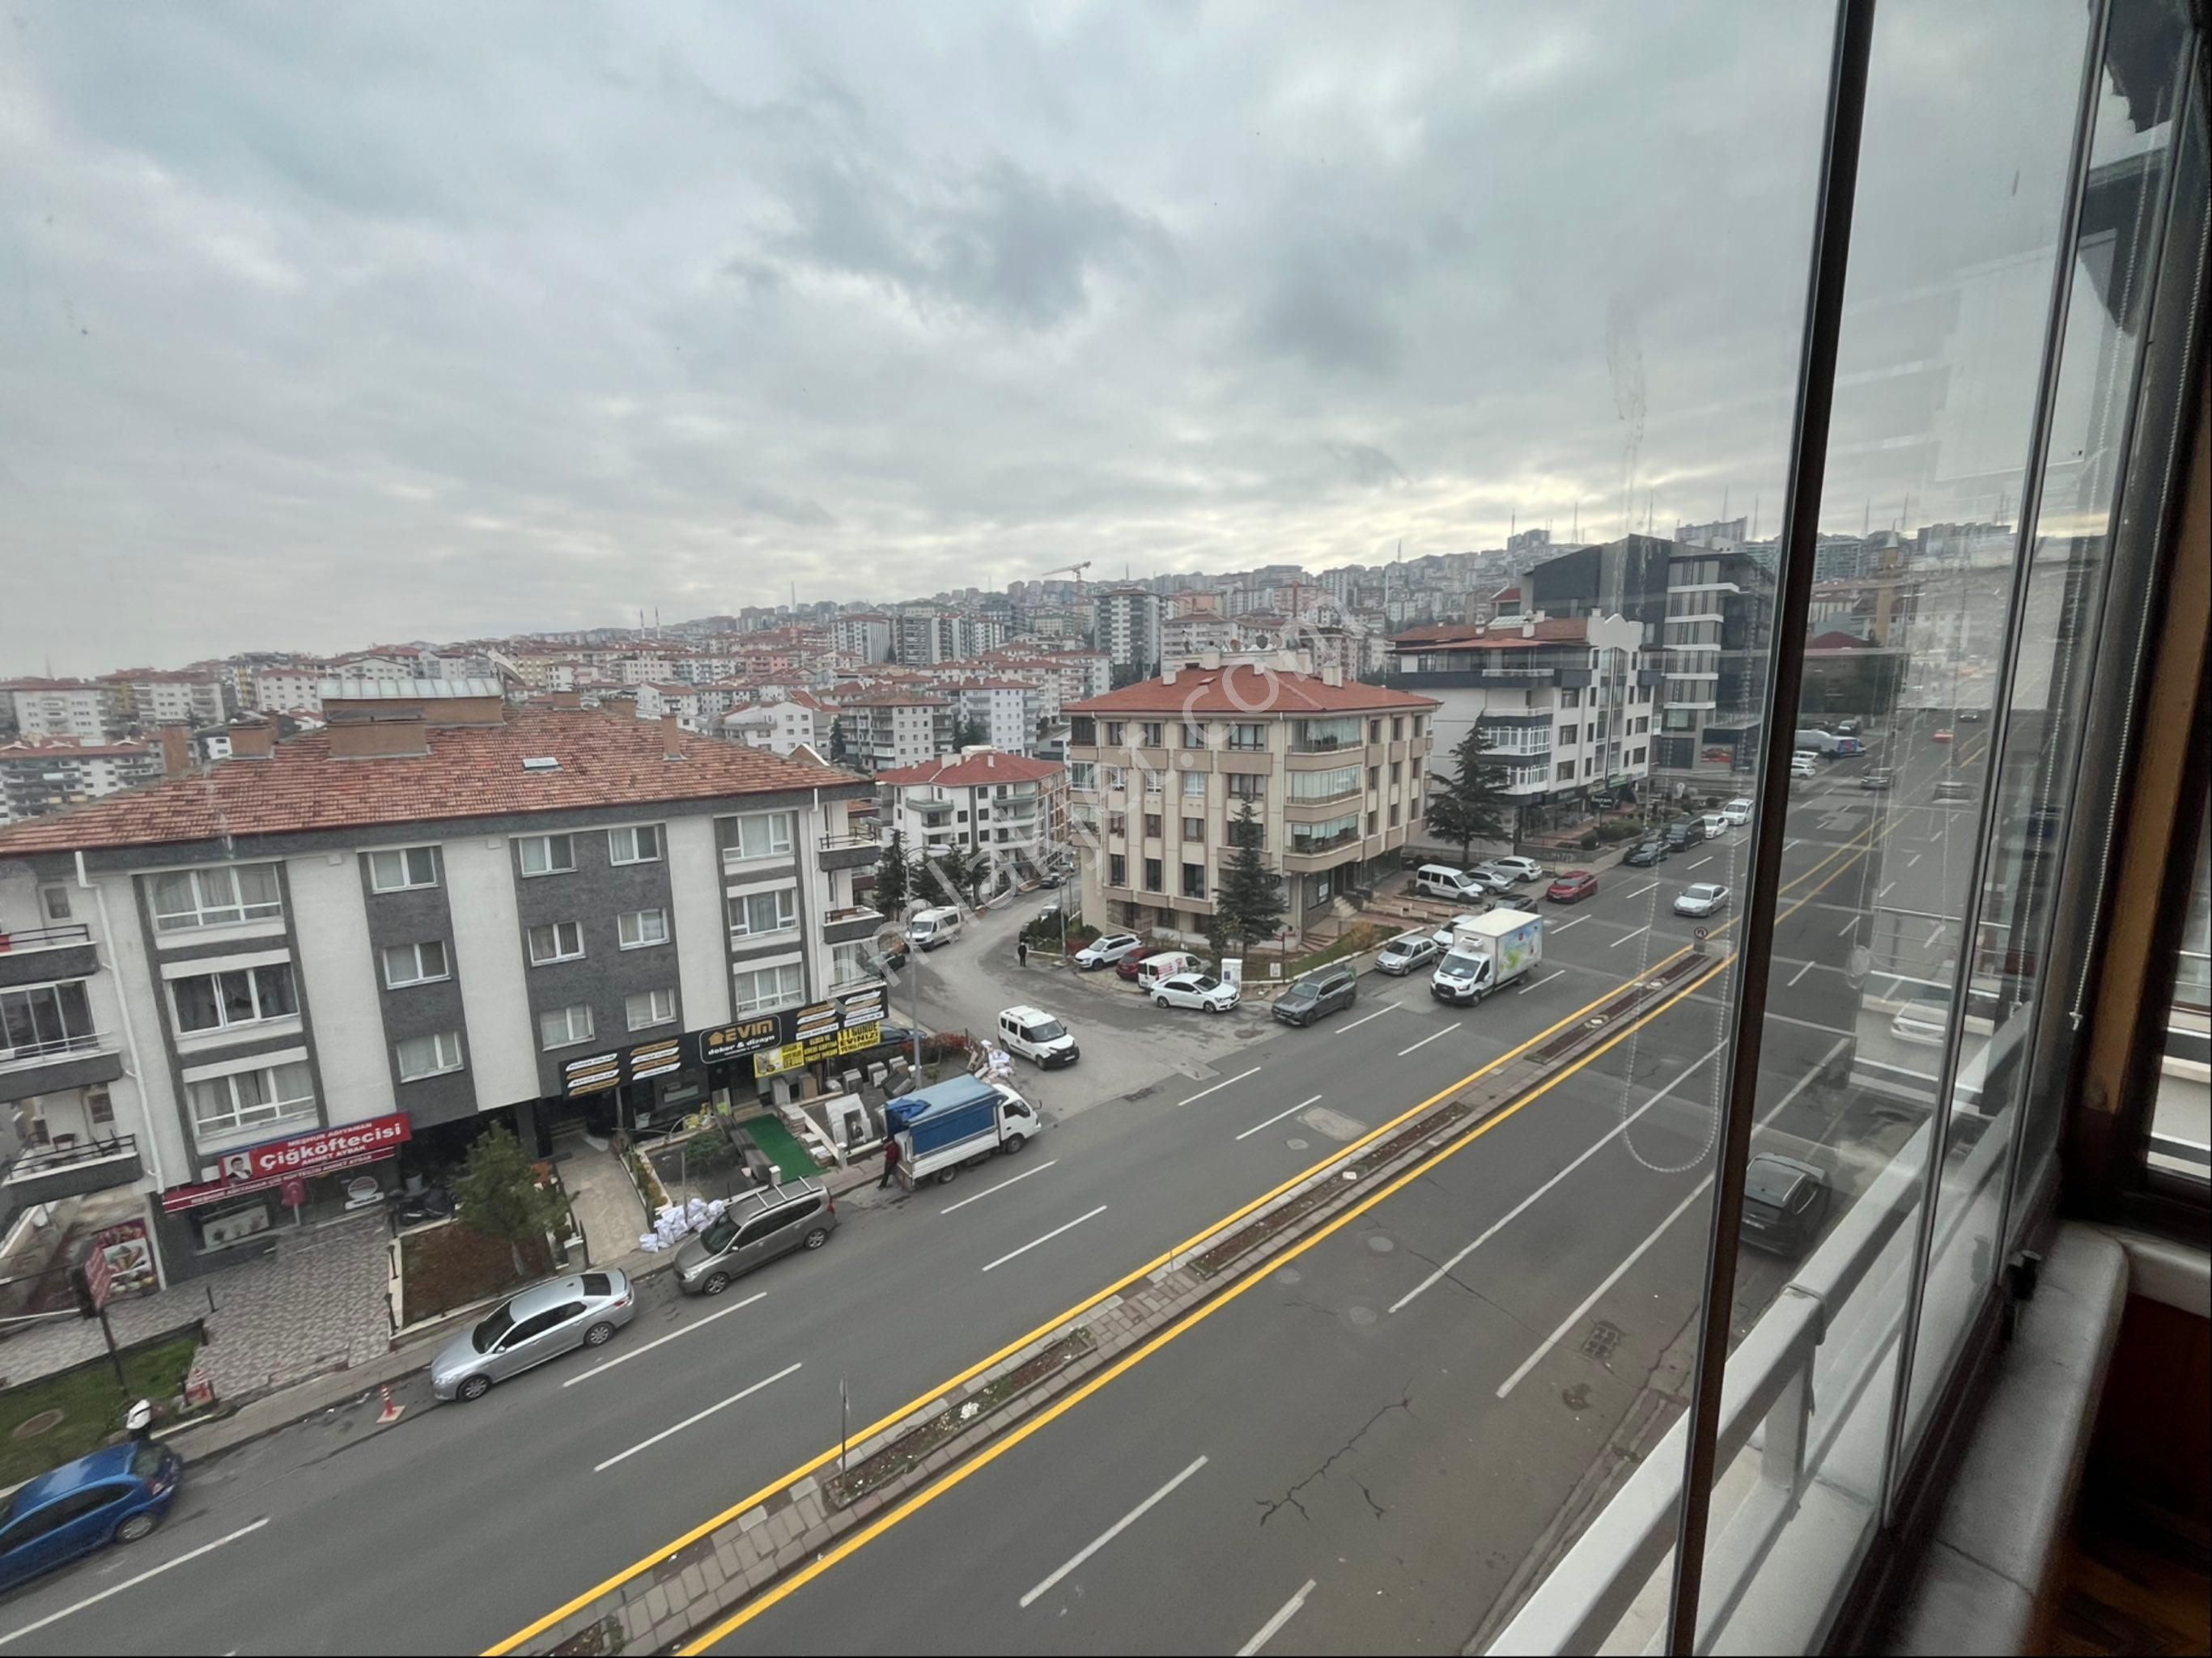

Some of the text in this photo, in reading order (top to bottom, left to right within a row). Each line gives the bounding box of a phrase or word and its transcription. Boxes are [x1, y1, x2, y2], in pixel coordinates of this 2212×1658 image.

[328, 1122, 373, 1138] ADIYAMAN
[259, 1122, 401, 1171] Çiğköftecisi
[301, 1145, 366, 1166] AHMET AYBAK
